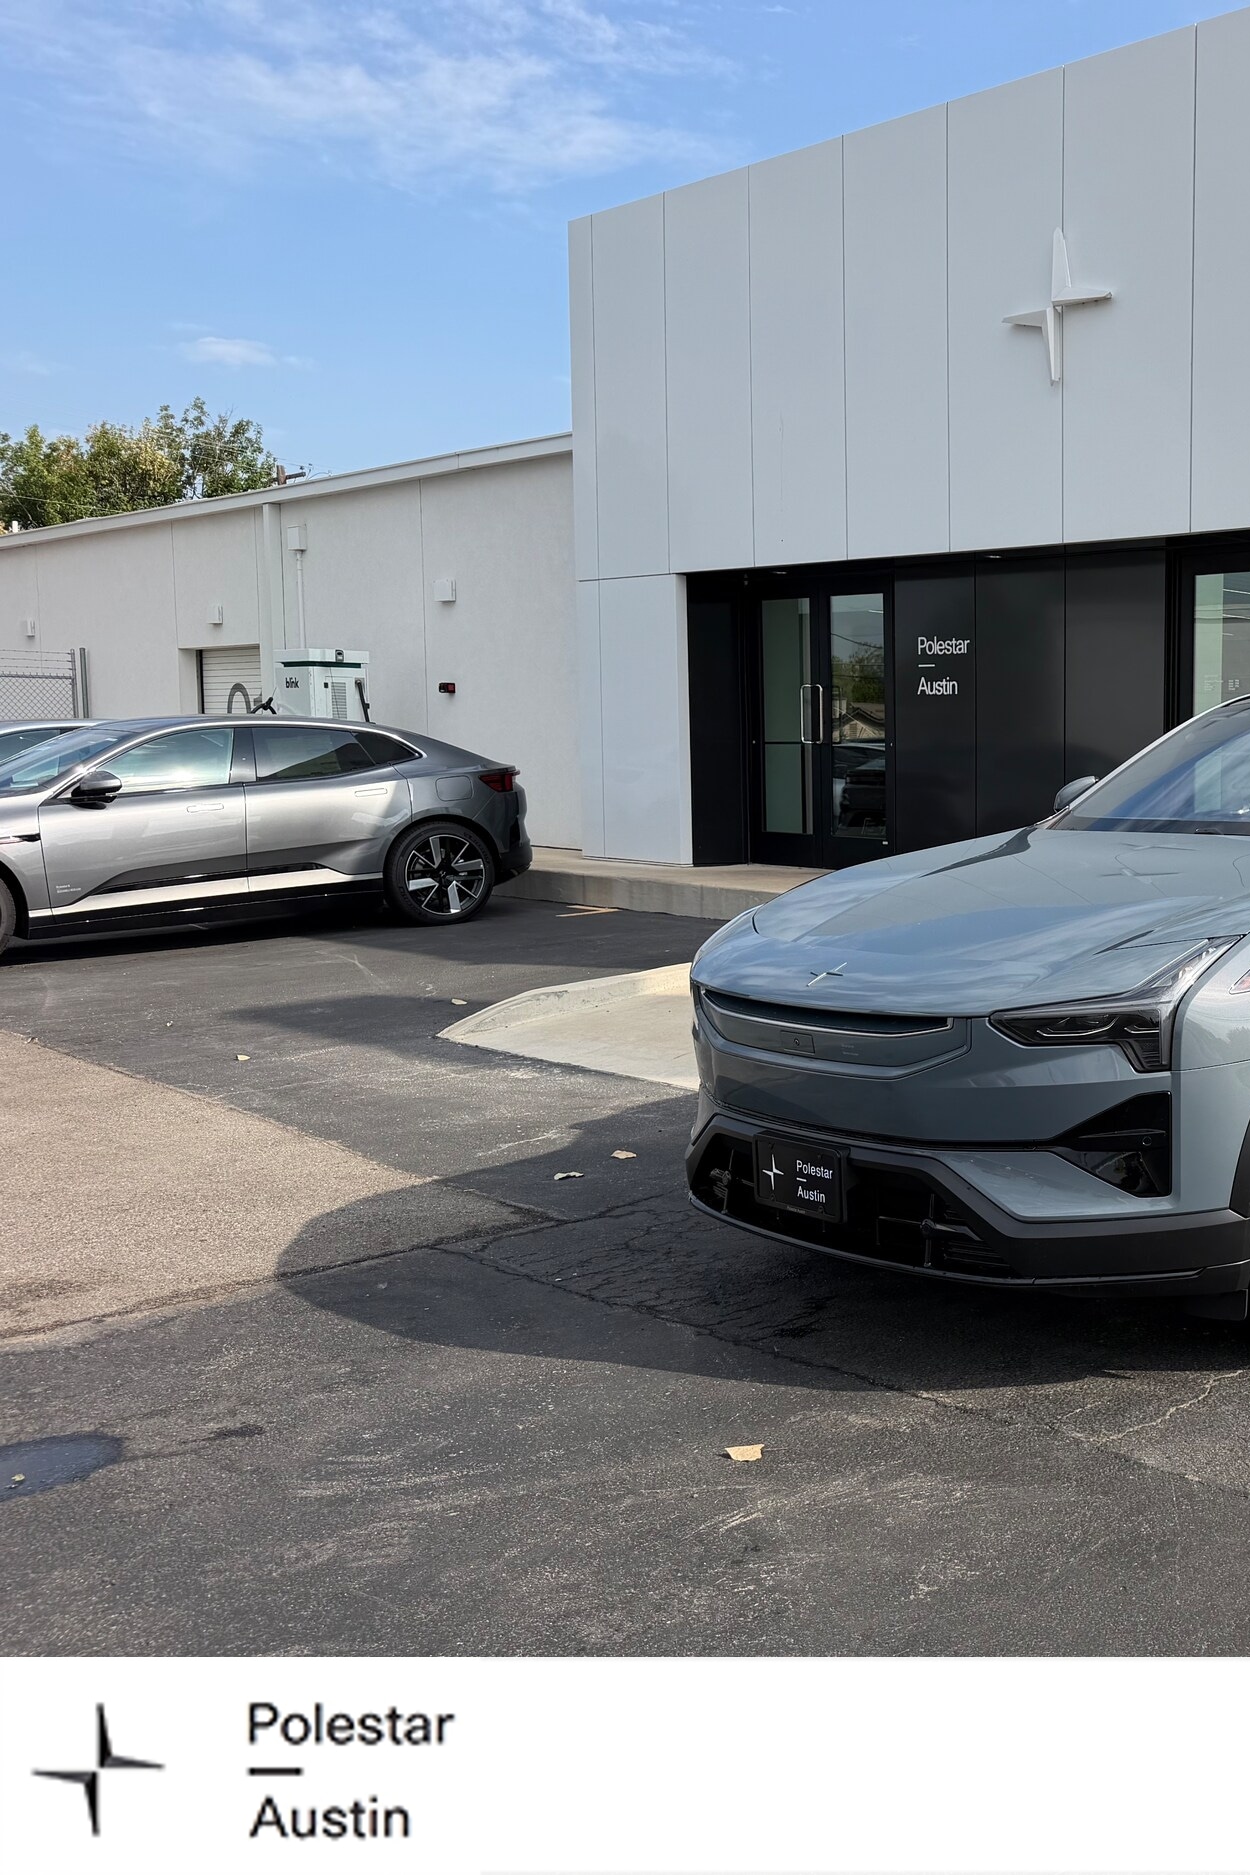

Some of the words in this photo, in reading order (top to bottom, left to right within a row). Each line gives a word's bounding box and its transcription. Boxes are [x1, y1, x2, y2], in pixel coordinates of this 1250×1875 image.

[918, 635, 970, 655] Polestar
[917, 677, 958, 695] Austin
[796, 1160, 833, 1179] Polestar
[797, 1186, 826, 1203] Austin
